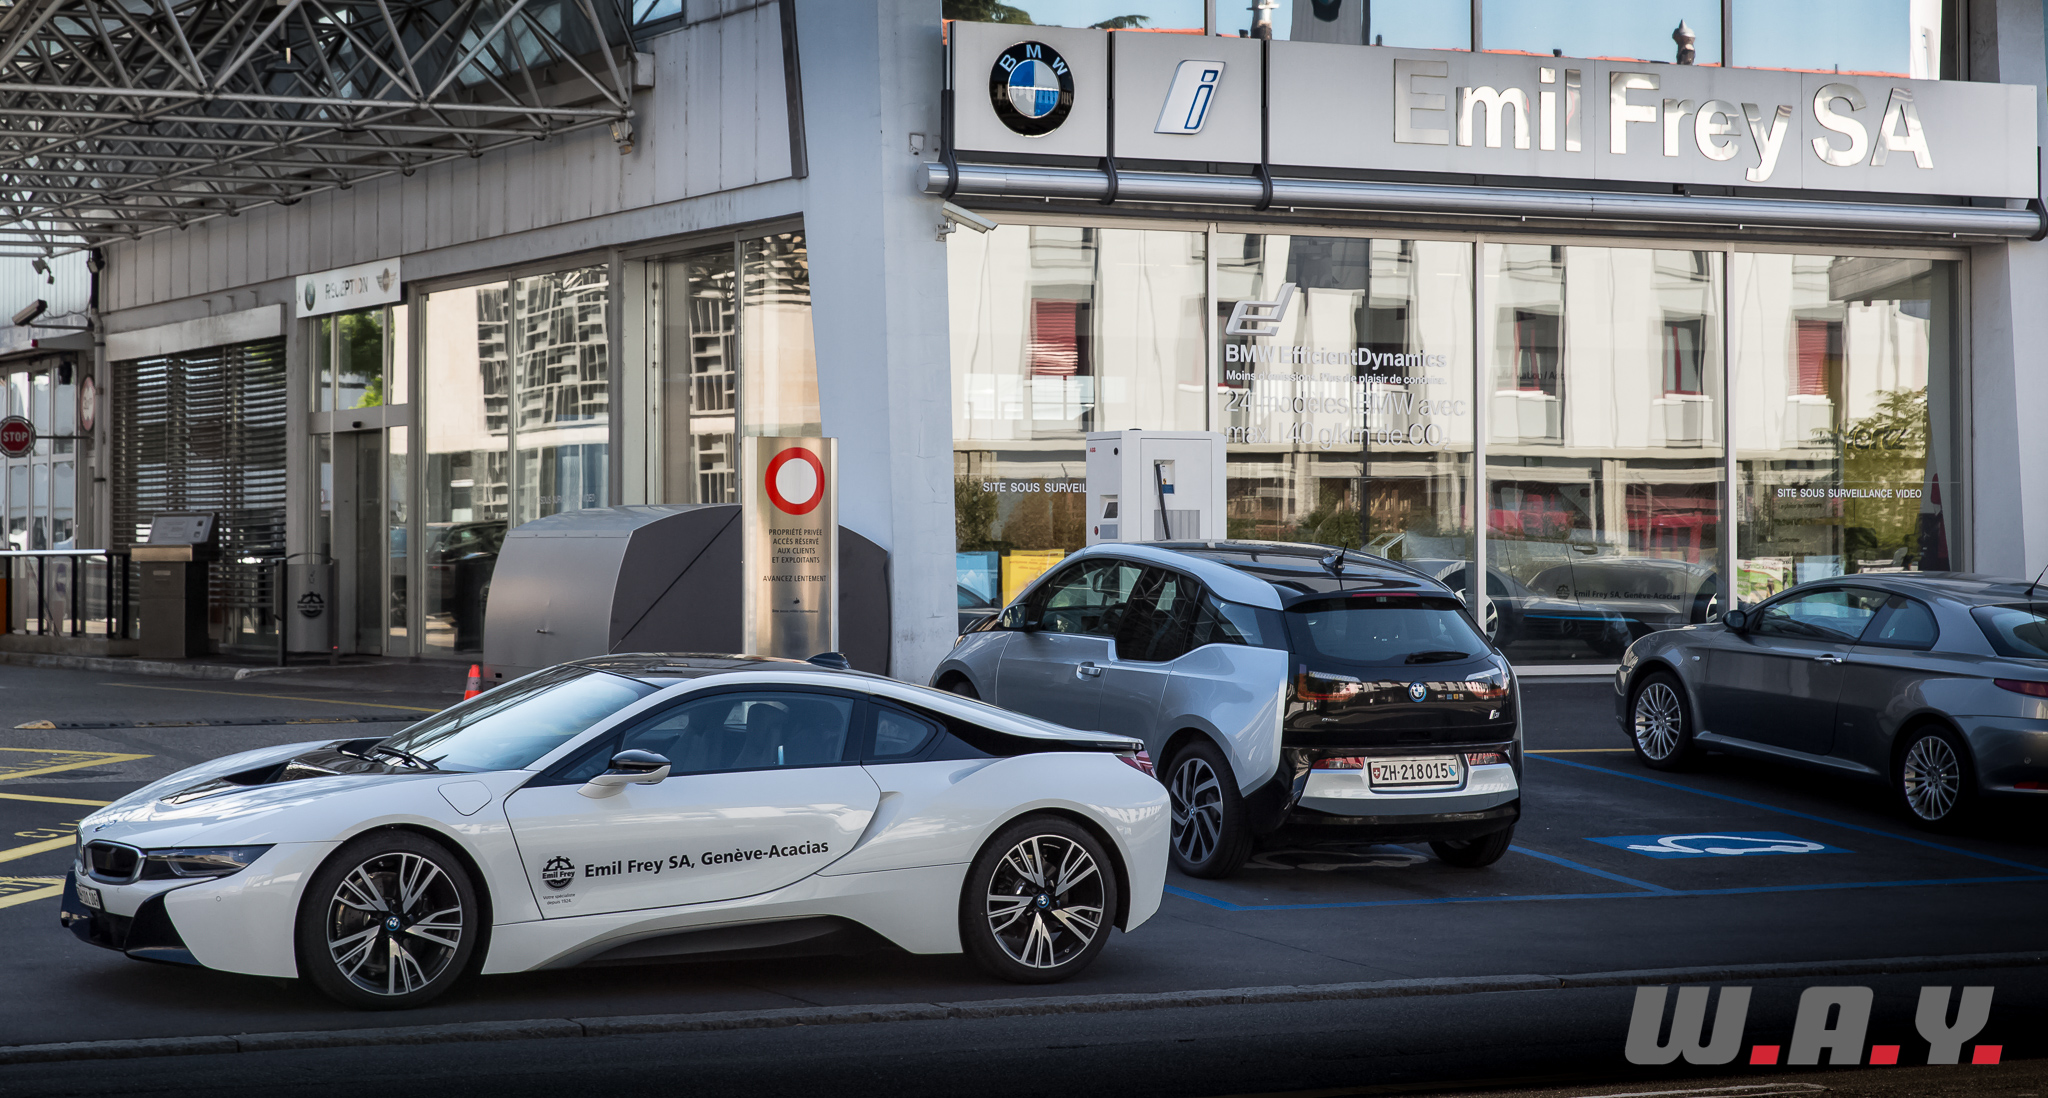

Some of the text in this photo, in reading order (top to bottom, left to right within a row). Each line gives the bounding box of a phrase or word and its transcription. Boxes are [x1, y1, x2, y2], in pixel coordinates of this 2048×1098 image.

[999, 43, 1068, 76] BMW
[1394, 58, 1934, 183] Emil Frey SA
[1225, 344, 1447, 371] BMW EfficientDynamics
[1226, 370, 1256, 381] Moins
[1358, 373, 1388, 384] plaisir
[1389, 374, 1402, 384] de
[1225, 389, 1466, 417] 24 modèles BMW avec
[2, 431, 28, 442] STOP
[1278, 421, 1314, 445] 140
[1318, 422, 1370, 451] g/km
[1377, 424, 1403, 446] de
[983, 482, 1087, 493] SITE SOUS SURVEIL
[1777, 488, 1922, 499] SITE SOUS SURVEILLANCE VIDEO
[768, 528, 823, 536] PROPRIÉTÉ PRIVÉE
[772, 537, 819, 545] ACCÈS RÉSERVÉ
[777, 547, 816, 555] AUX CLIENTS
[771, 556, 820, 564] ET EXPLOITANTS
[1574, 589, 1591, 598] Emil
[1592, 590, 1608, 599] Frey
[584, 840, 829, 878] Emil Frey SA, Genève-Acacias
[542, 870, 576, 880] Emil Frey
